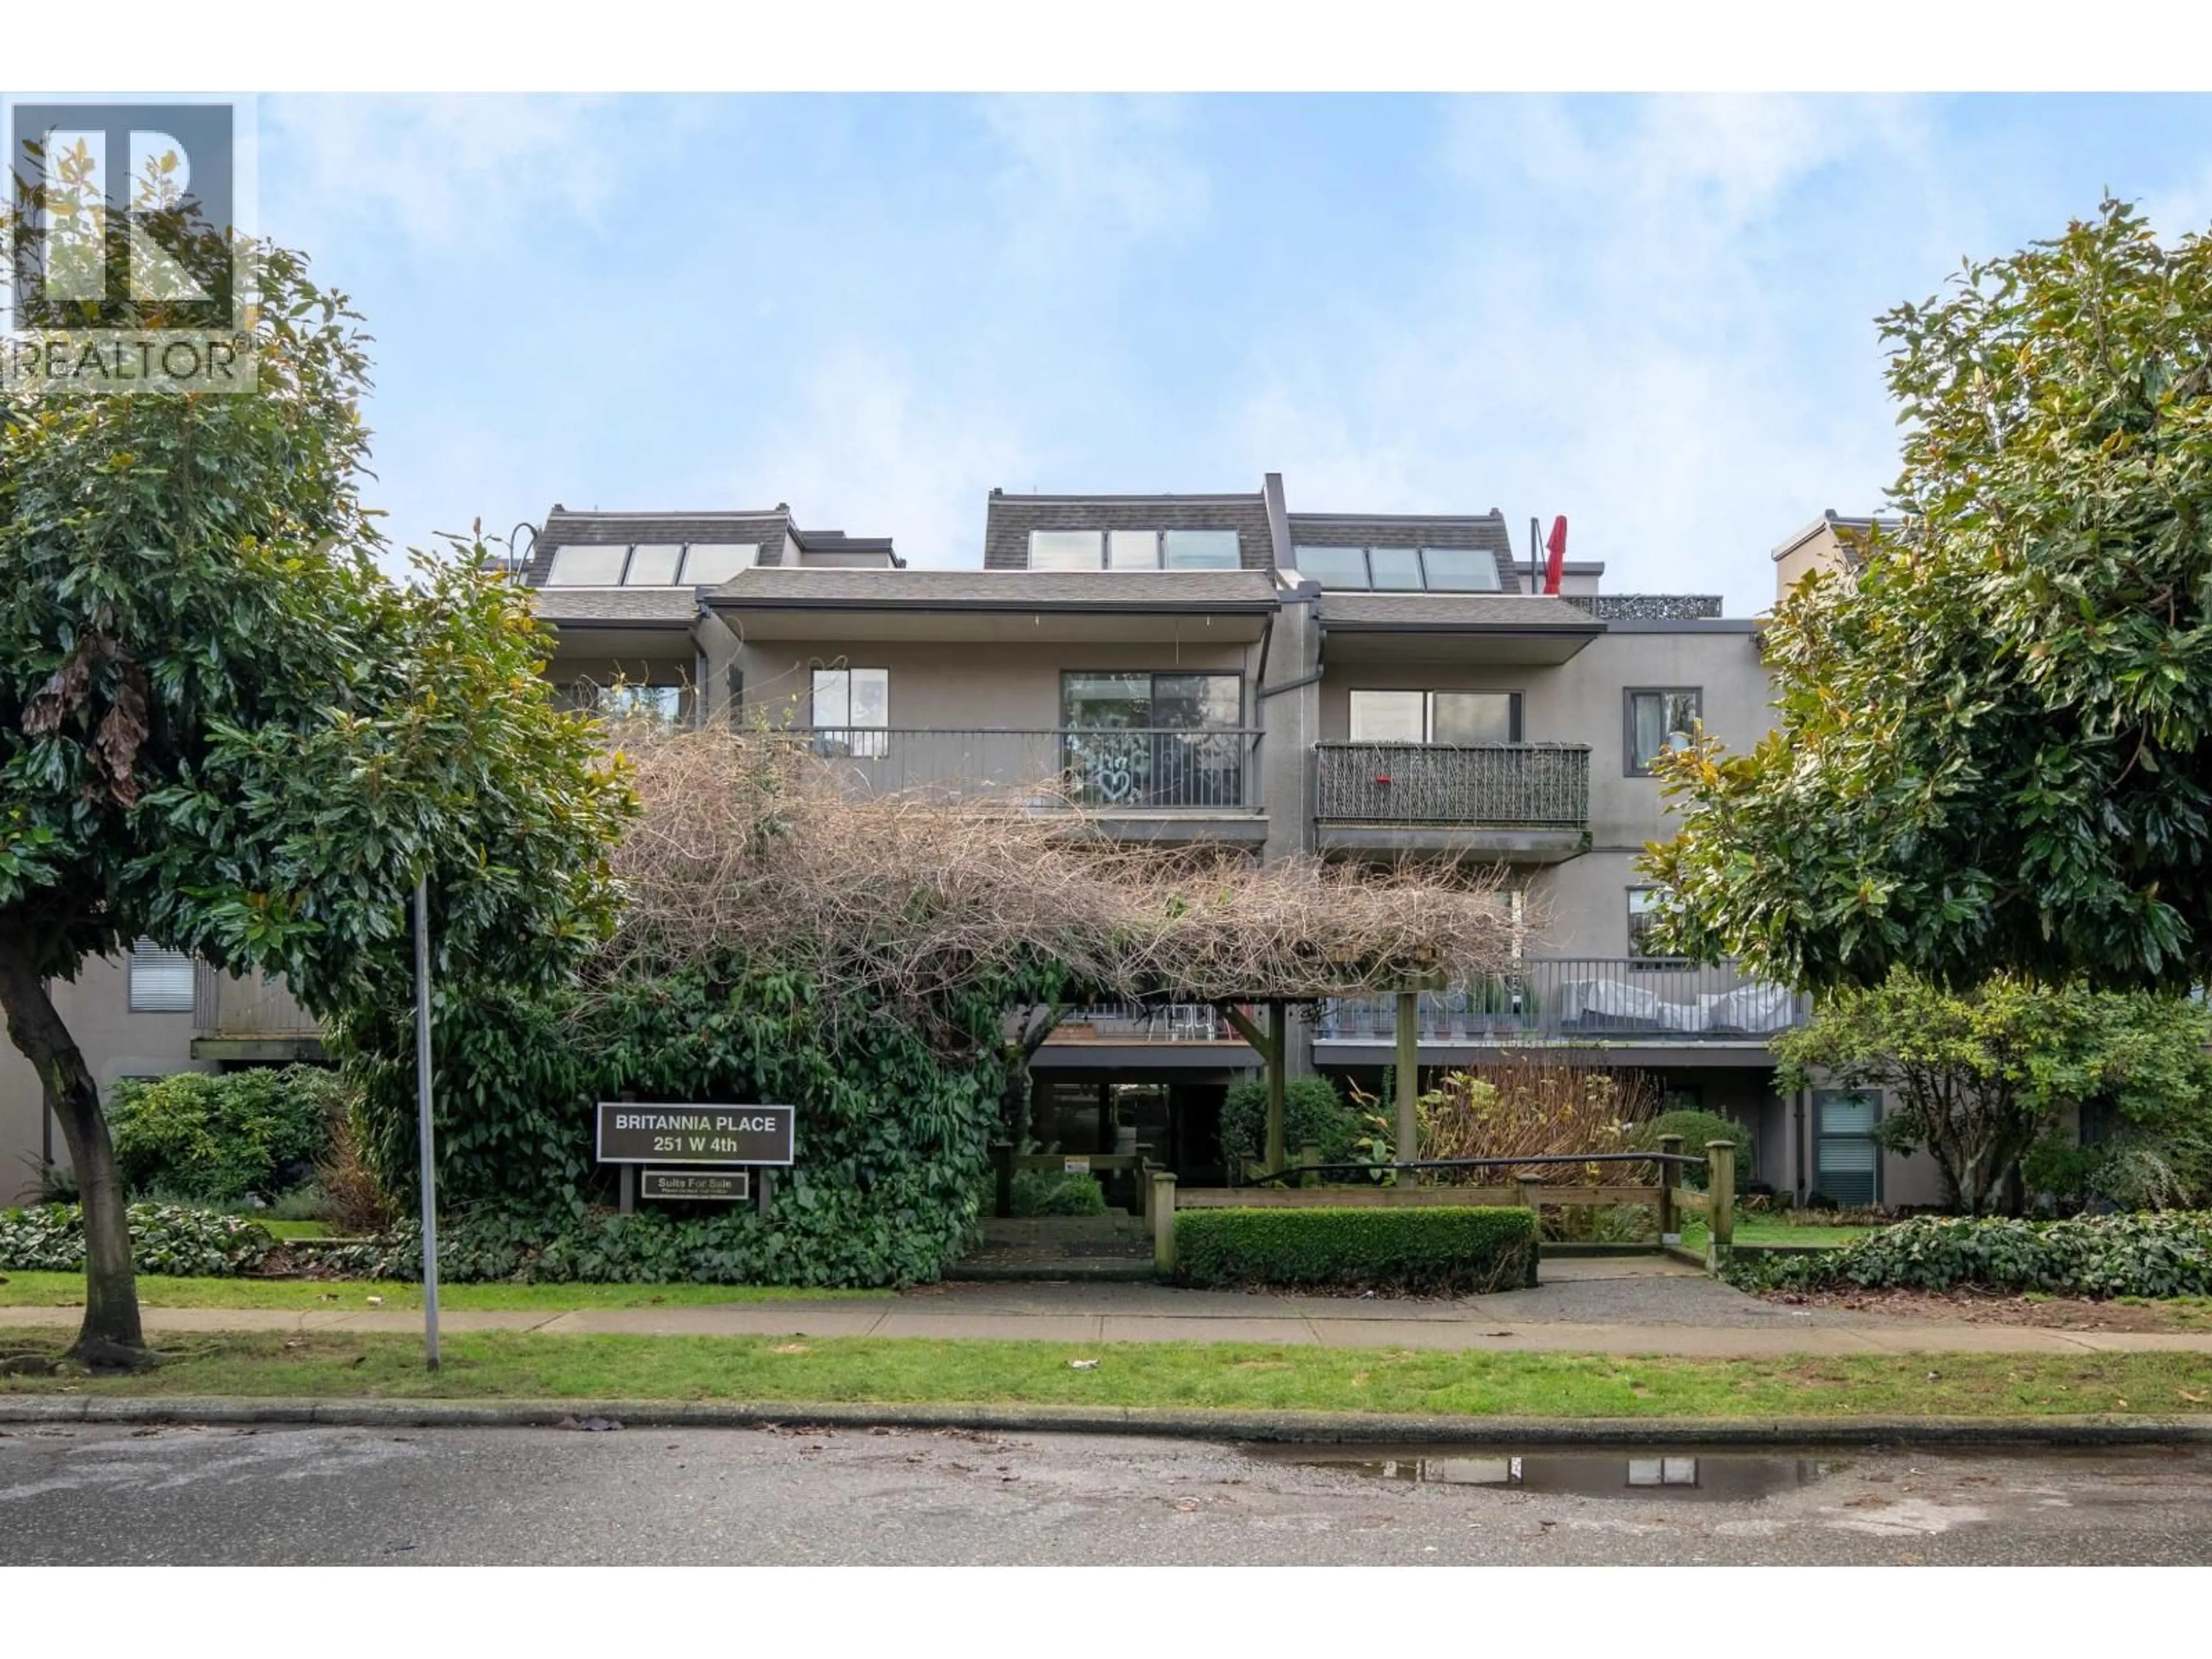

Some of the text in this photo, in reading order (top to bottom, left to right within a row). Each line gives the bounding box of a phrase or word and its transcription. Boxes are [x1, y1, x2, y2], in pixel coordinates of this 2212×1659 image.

[616, 1114, 776, 1132] BRITANNIA PLACE
[653, 1136, 737, 1152] 251 W 4th
[688, 1178, 707, 1188] For
